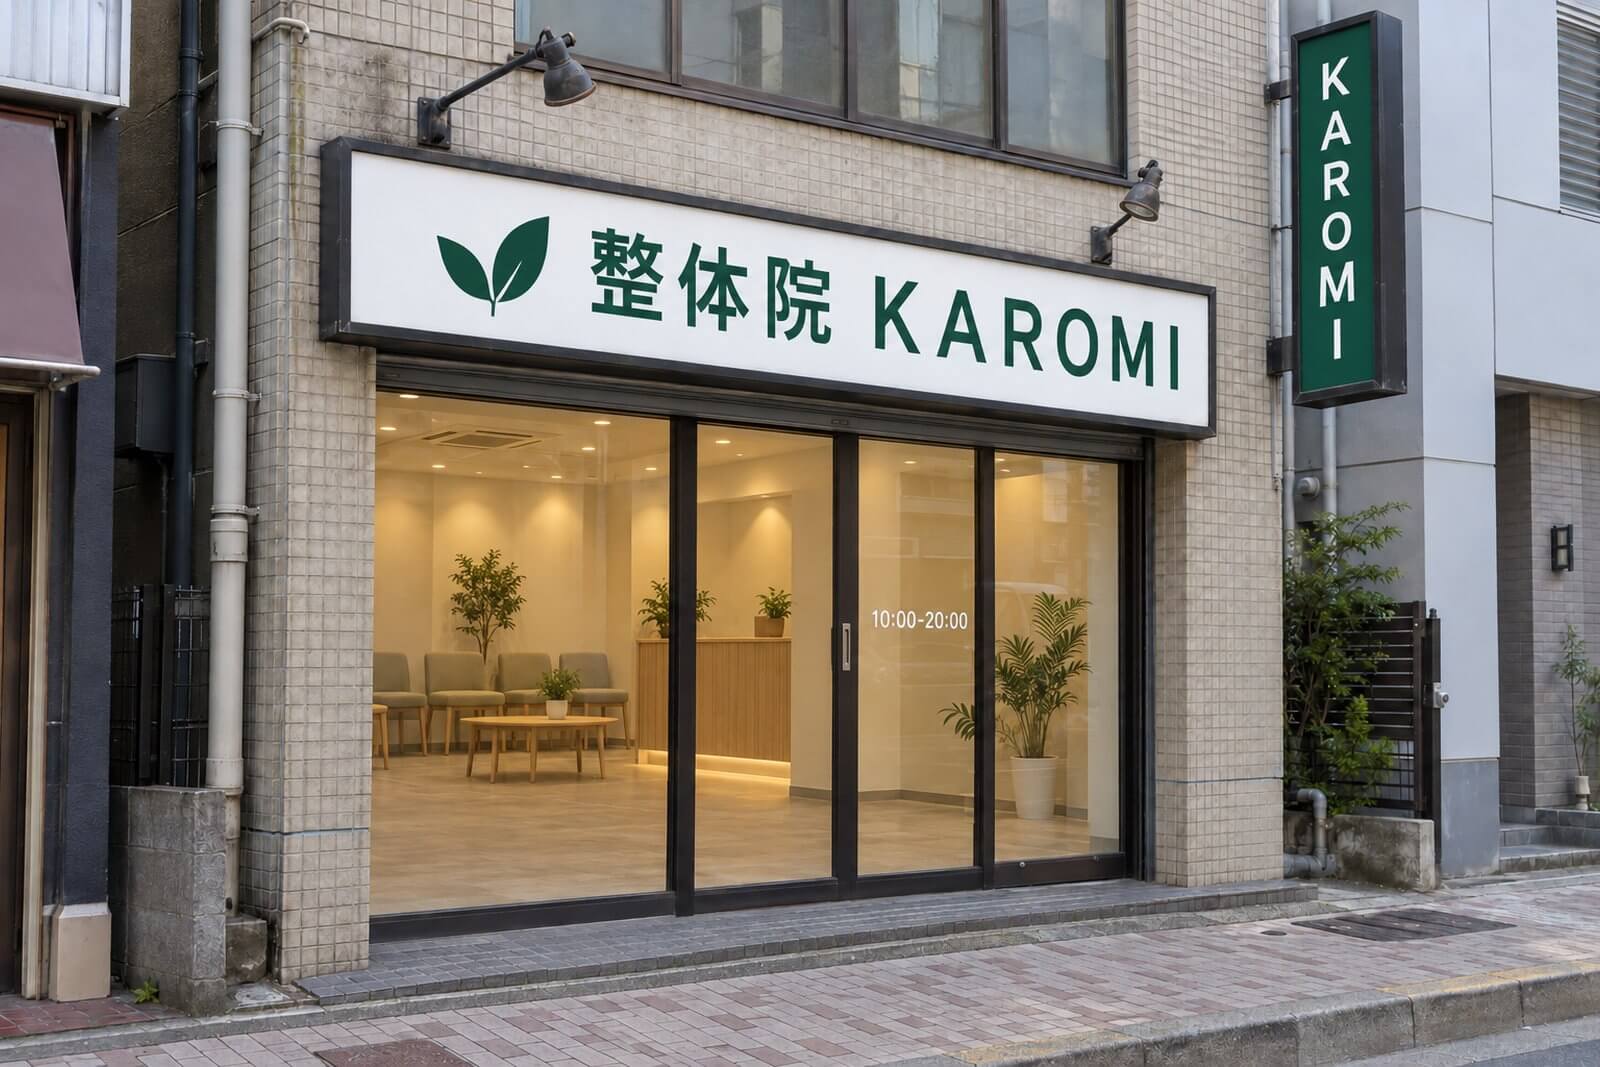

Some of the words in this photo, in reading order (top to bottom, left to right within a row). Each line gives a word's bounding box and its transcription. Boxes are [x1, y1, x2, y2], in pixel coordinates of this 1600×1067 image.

[1320, 56, 1355, 361] KAROMI
[591, 228, 832, 345] 整体院
[875, 276, 1179, 390] KAROMI
[872, 609, 968, 629] 10:00-20:00
